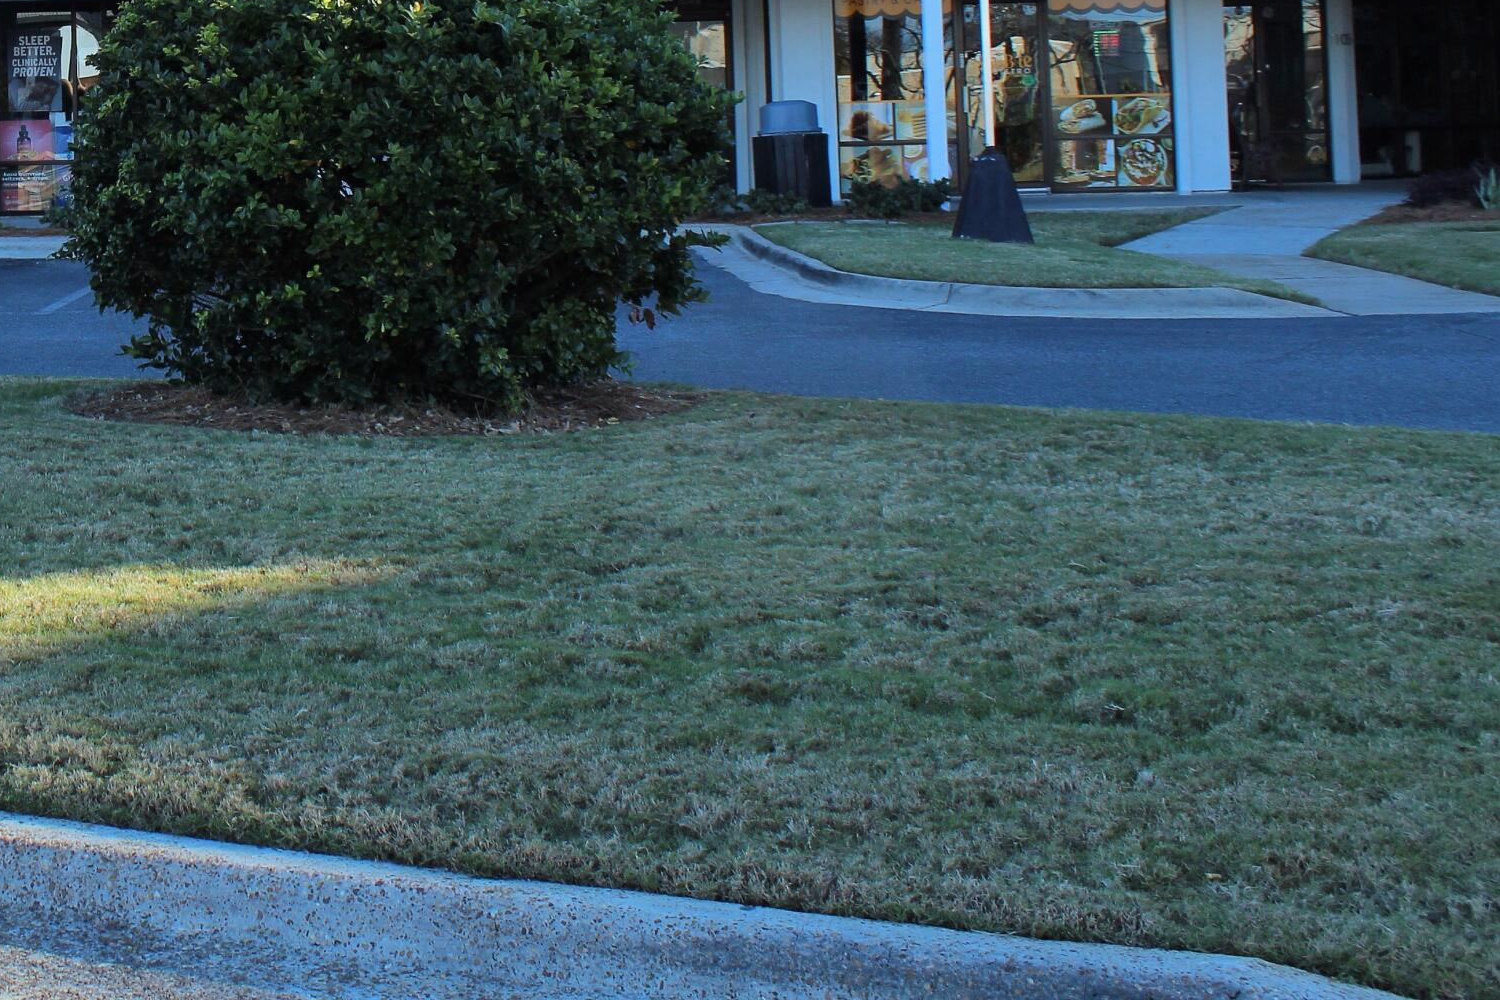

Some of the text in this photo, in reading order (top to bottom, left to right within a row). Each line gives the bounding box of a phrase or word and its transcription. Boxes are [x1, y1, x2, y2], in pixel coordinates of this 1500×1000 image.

[18, 35, 51, 46] SLEEP
[13, 45, 56, 57] BETTER.
[12, 57, 58, 67] CLINICALLY
[12, 66, 57, 78] PROVEN.
